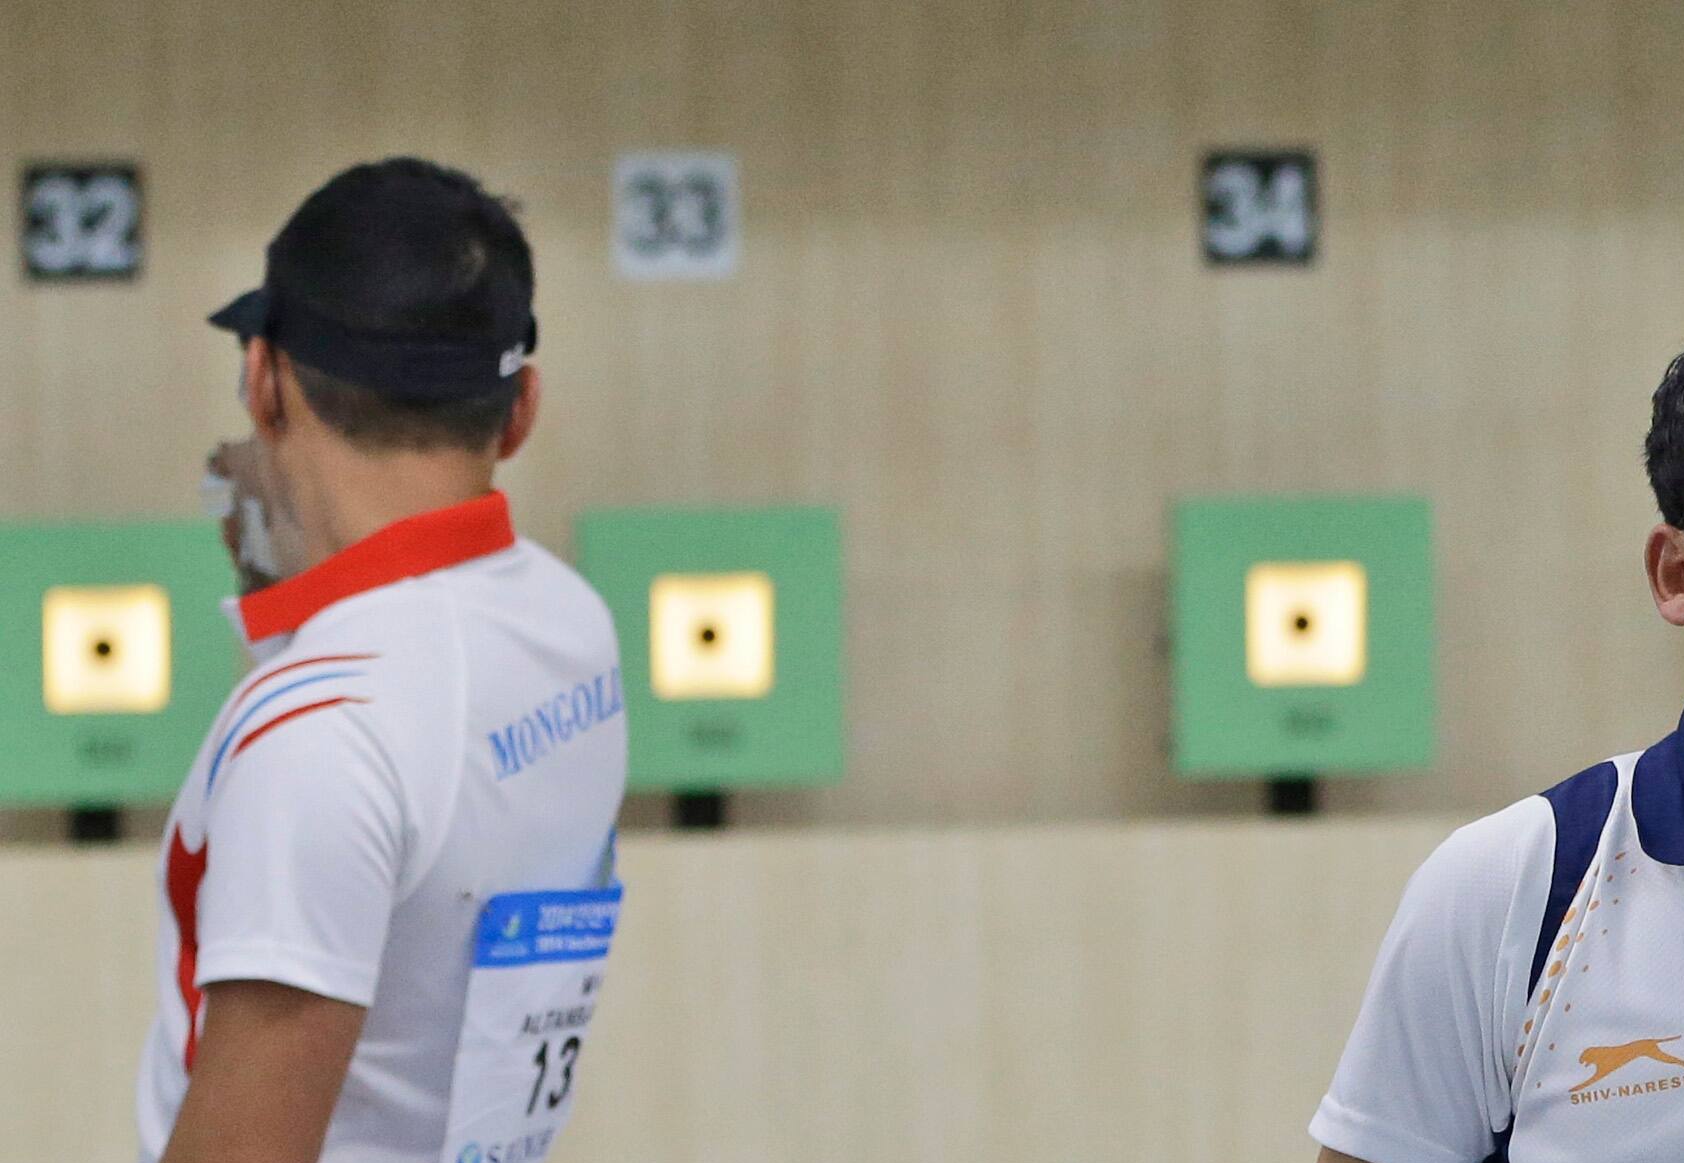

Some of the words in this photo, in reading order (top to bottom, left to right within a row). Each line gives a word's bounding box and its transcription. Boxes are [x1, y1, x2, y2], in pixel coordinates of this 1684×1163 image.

[30, 175, 135, 269] 32
[627, 172, 724, 256] 33
[1208, 164, 1306, 256] 34
[525, 1035, 582, 1117] 13
